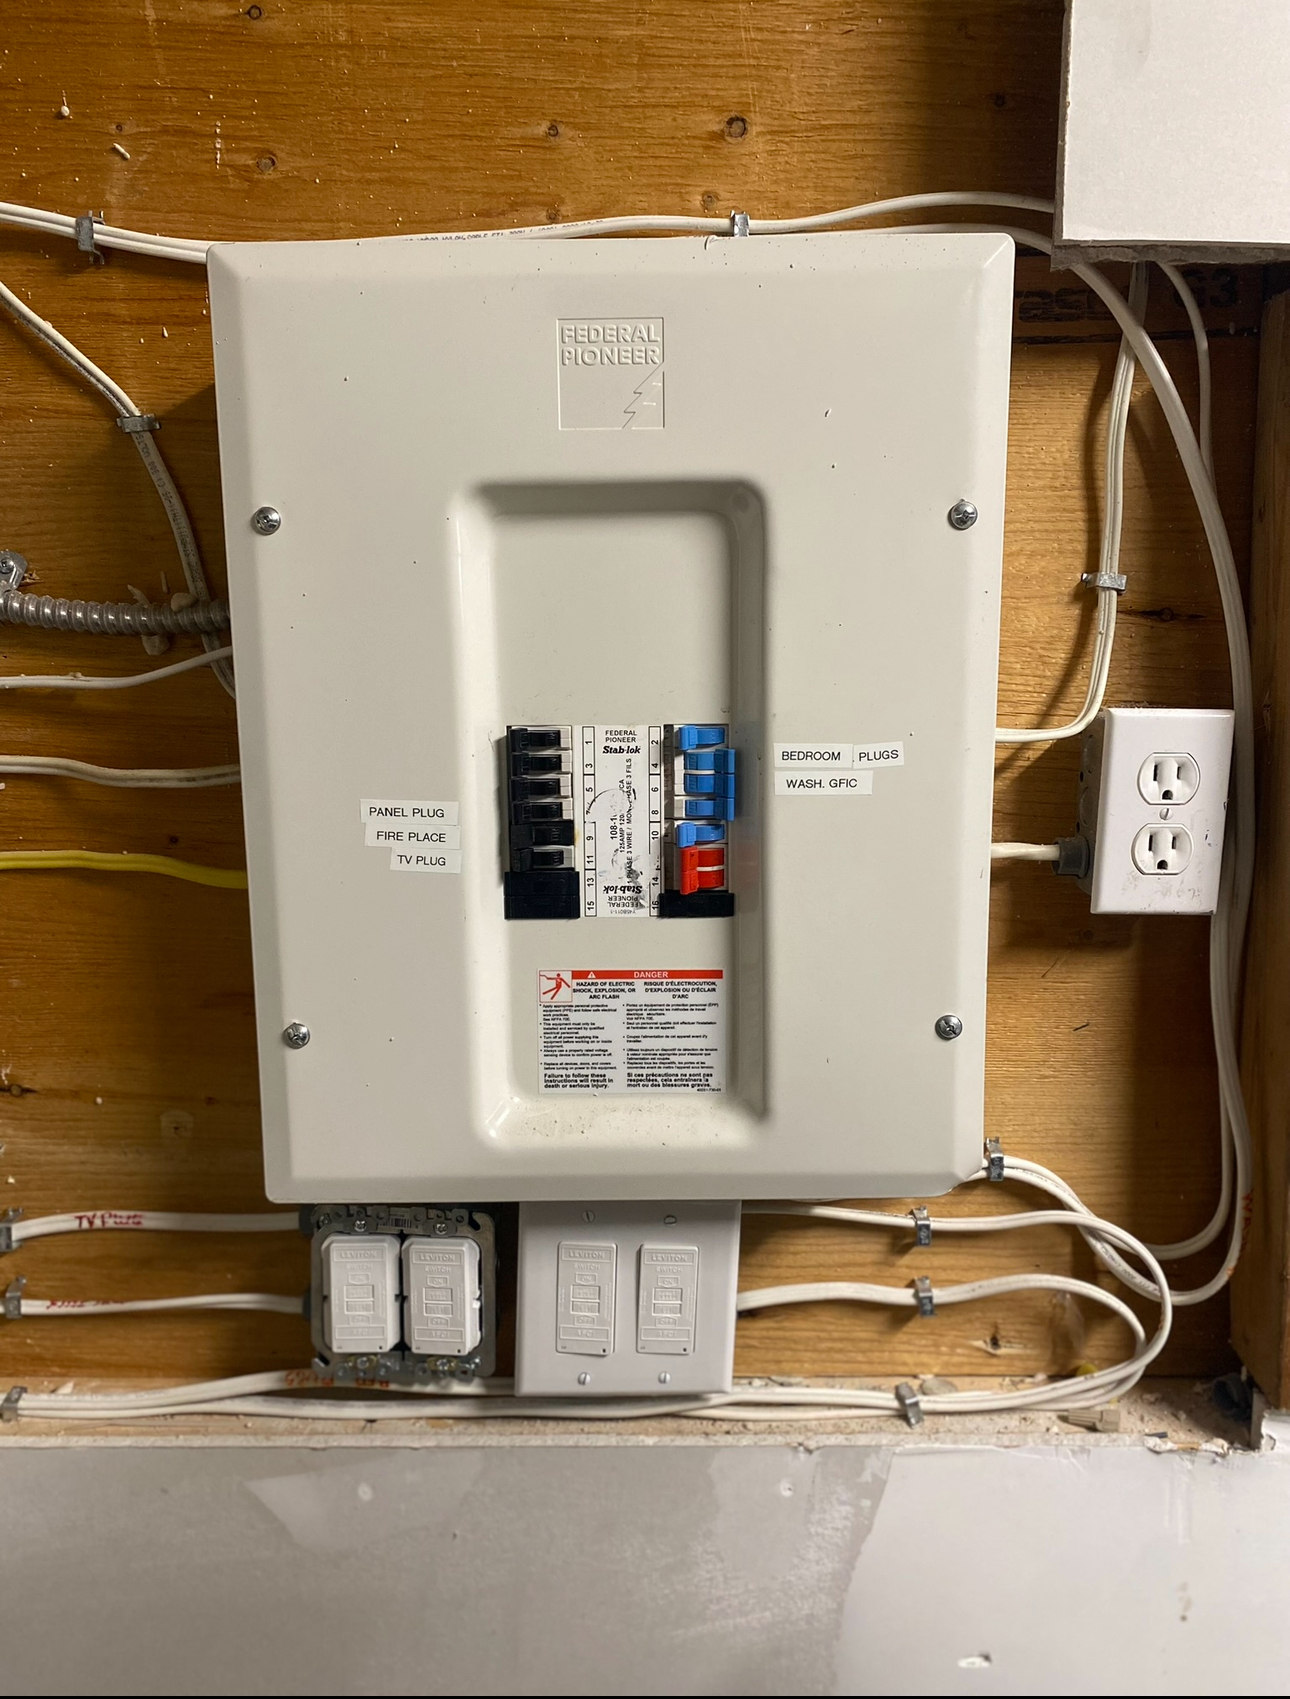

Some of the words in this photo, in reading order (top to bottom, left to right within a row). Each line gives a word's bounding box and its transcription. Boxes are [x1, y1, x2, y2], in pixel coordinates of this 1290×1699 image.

[562, 324, 660, 344] FEDERAL
[562, 346, 660, 366] PIONEER
[782, 751, 841, 761] BEDROOM
[859, 750, 899, 761] PLUGS
[786, 779, 825, 788] WASH.
[829, 778, 858, 788] GFIC
[370, 807, 408, 817] PANEL
[412, 808, 445, 818] PLUG
[376, 831, 404, 841] FIRE
[408, 832, 446, 842] PLACE
[651, 831, 659, 840] 10
[397, 855, 412, 864] TV
[416, 856, 446, 866] PLUG
[587, 855, 593, 864] 11
[587, 878, 594, 887] 13
[652, 877, 659, 886] 14
[587, 901, 594, 910] 15
[652, 900, 659, 910] 16
[74, 1212, 96, 1228] TV
[569, 1250, 605, 1259] LEVITON
[651, 1254, 687, 1262] LEVITON
